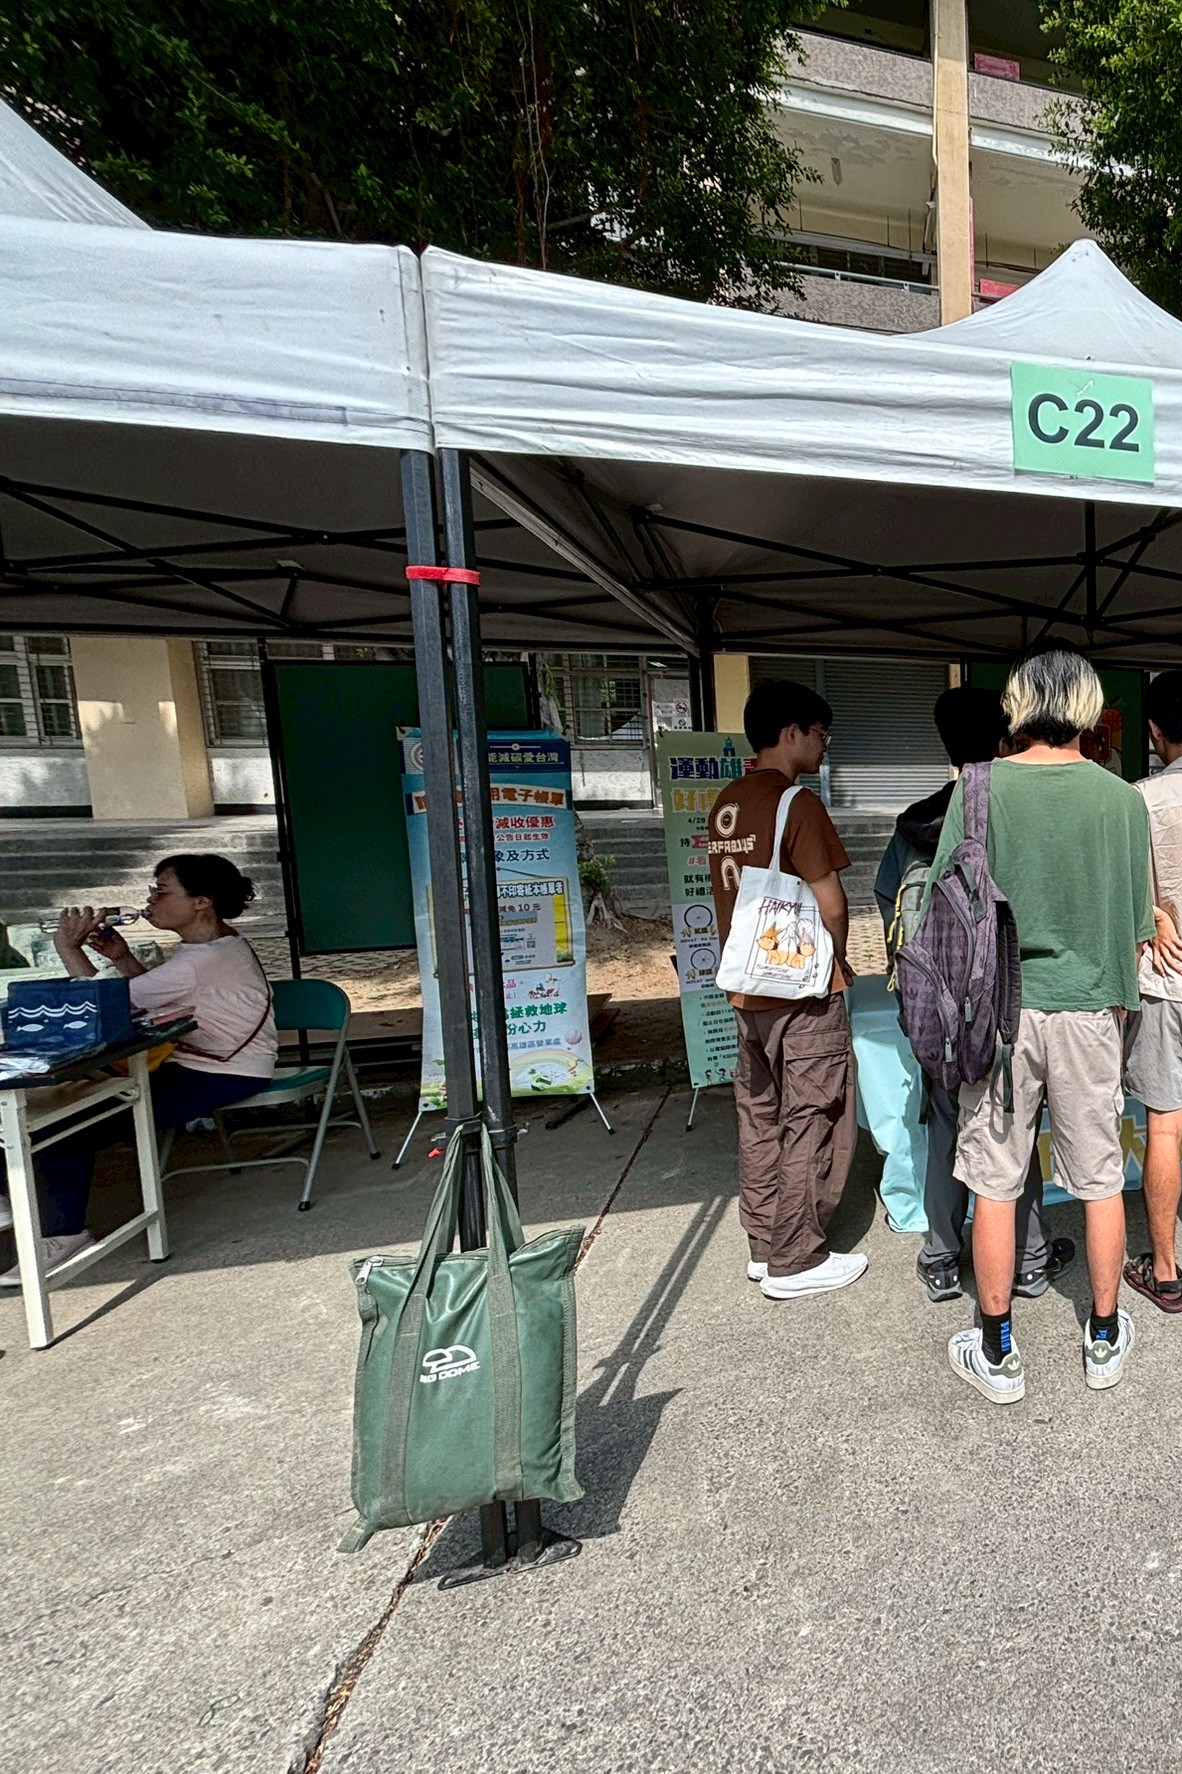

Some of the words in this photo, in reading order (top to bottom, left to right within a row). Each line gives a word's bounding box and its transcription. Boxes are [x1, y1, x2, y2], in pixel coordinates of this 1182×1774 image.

[1028, 393, 1140, 452] C22
[495, 815, 555, 830] 減收優惠
[496, 832, 549, 843] 公告日起生效
[532, 903, 541, 911] 元
[507, 1037, 562, 1051] 高雄區營業處
